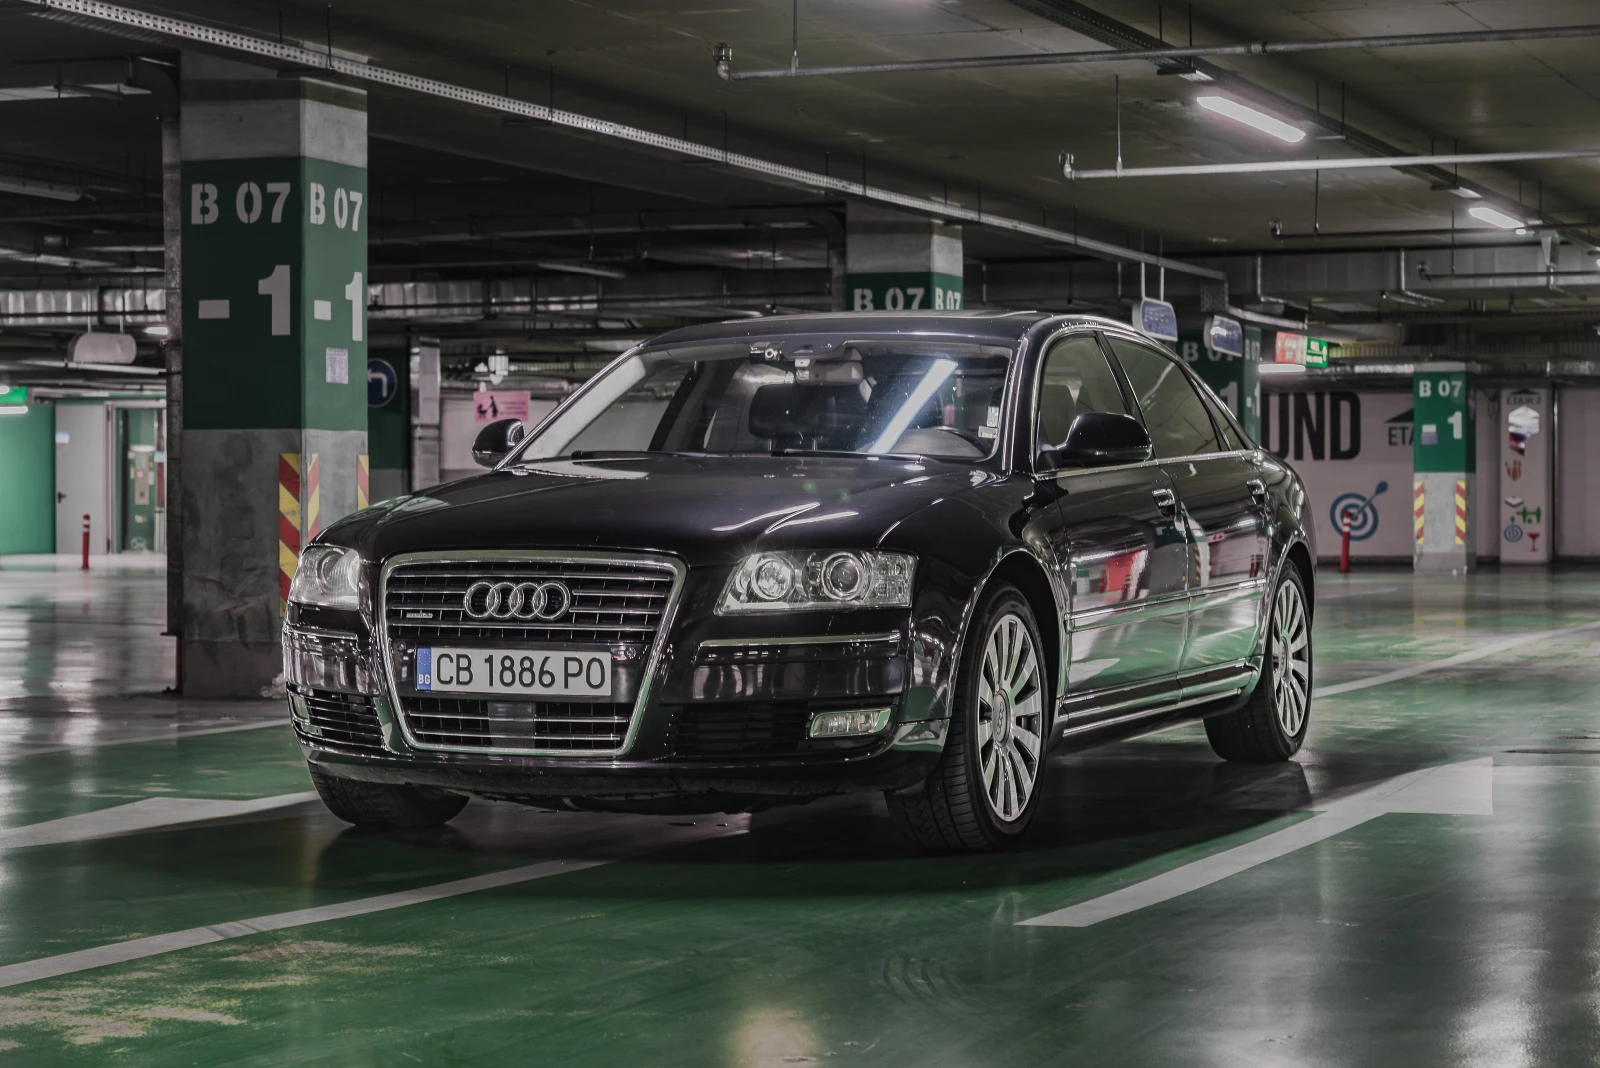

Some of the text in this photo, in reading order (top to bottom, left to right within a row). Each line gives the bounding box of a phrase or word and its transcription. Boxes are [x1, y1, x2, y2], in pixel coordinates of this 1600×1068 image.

[191, 182, 291, 225] B 07
[310, 182, 363, 232] B 07
[853, 287, 925, 311] B 07
[935, 287, 961, 311] B 07
[1182, 341, 1199, 362] B
[1419, 380, 1463, 398] B 07
[418, 674, 430, 685] BG
[436, 653, 474, 685] CB
[484, 654, 556, 688] 1886
